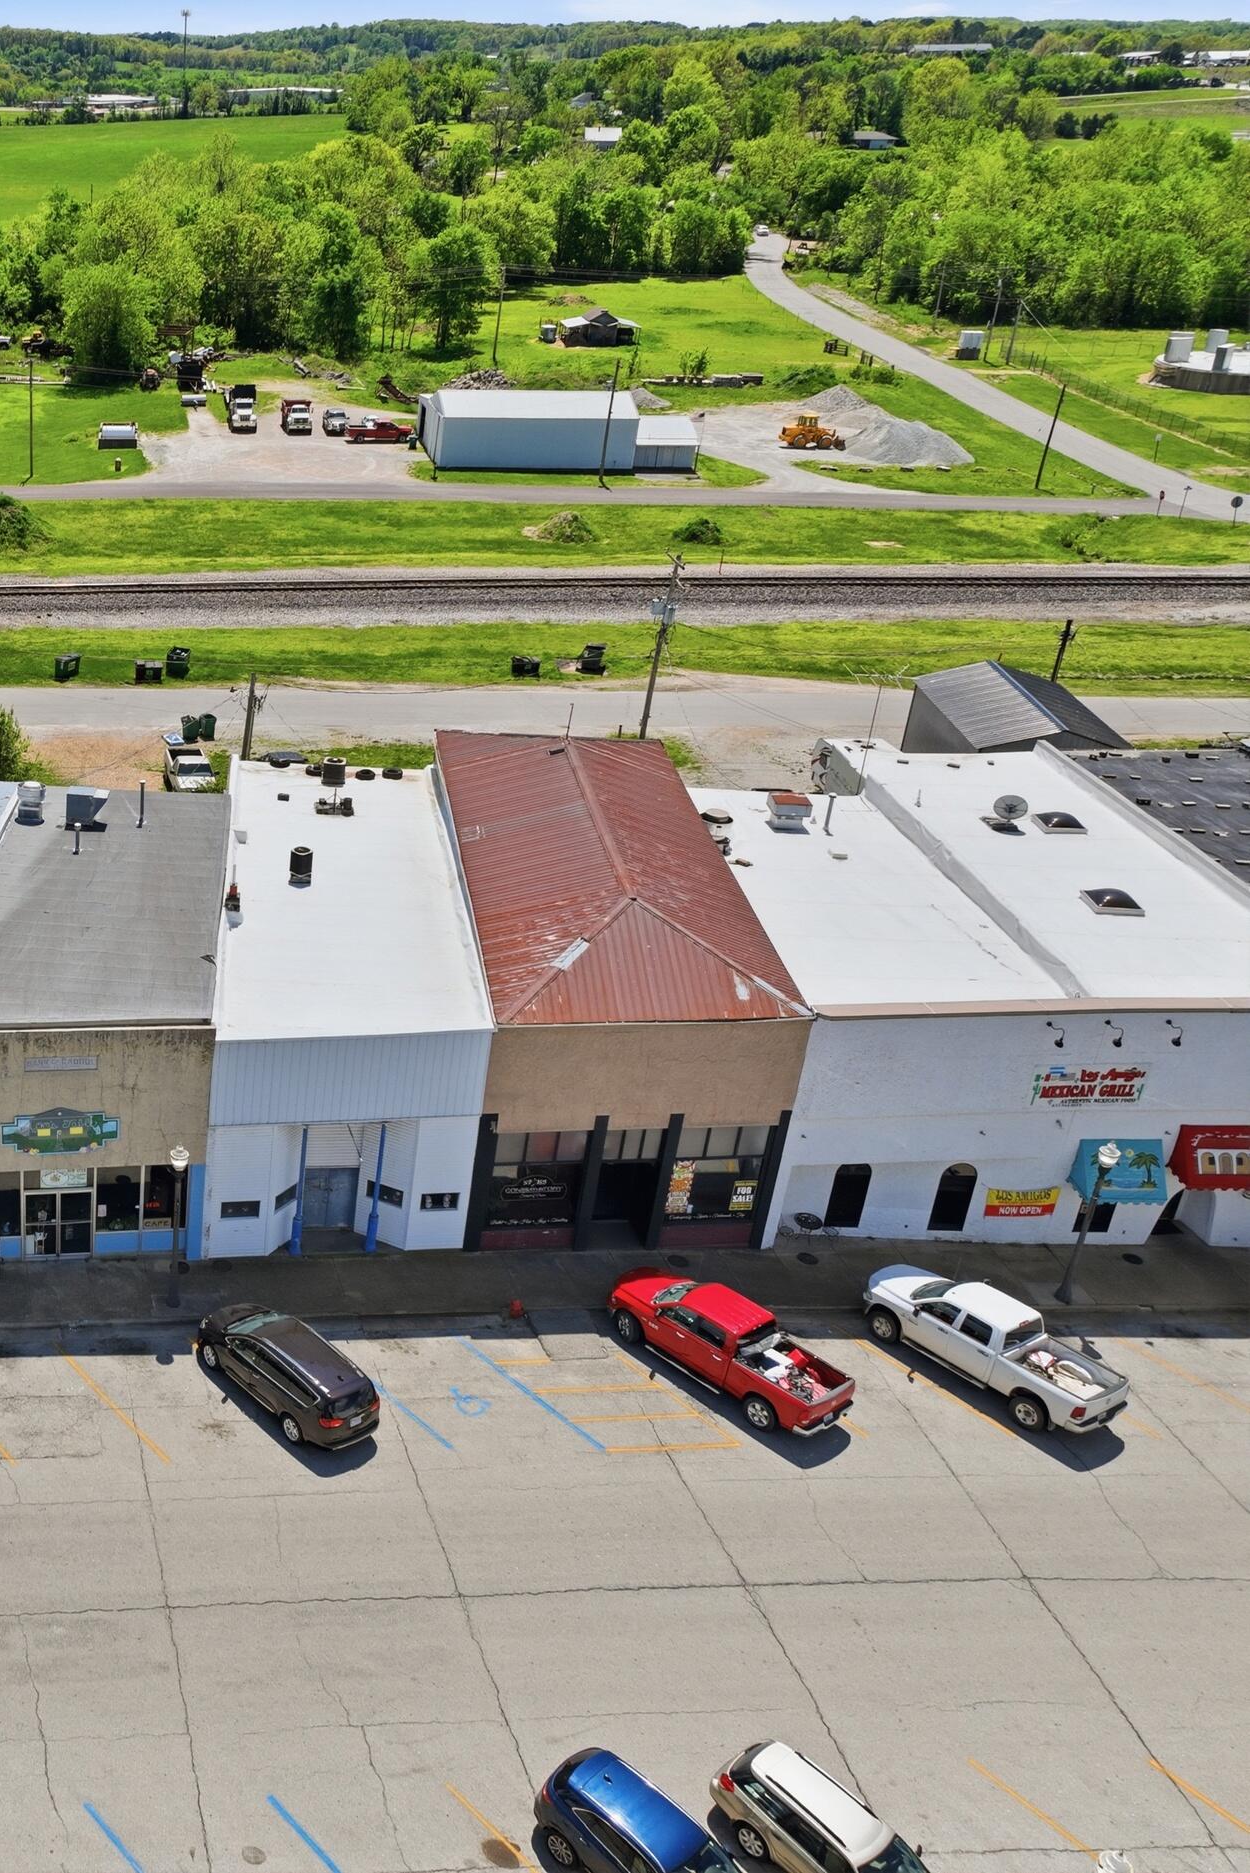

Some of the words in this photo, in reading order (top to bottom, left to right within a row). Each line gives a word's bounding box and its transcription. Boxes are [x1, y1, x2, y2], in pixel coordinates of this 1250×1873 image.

[1039, 1084, 1097, 1098] MEXICAN
[1099, 1084, 1135, 1097] GRILL
[736, 1186, 753, 1195] FOR
[996, 1190, 1014, 1201] LOS
[1015, 1189, 1052, 1201] AMIGOS
[999, 1206, 1018, 1215] NOW
[1019, 1206, 1043, 1215] OPEN
